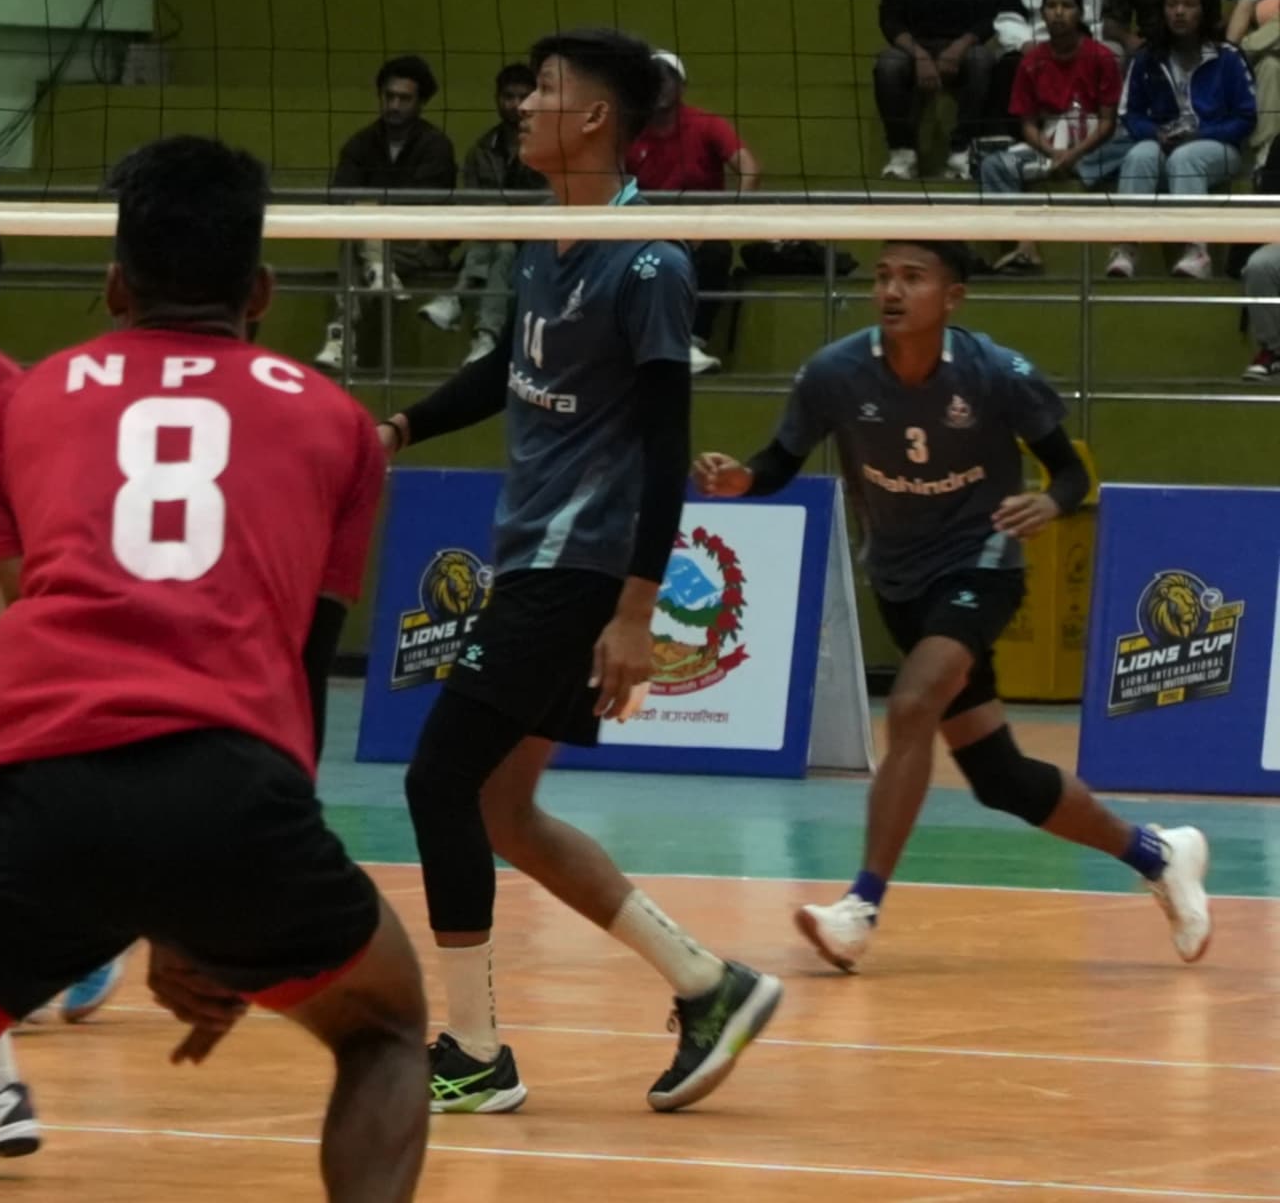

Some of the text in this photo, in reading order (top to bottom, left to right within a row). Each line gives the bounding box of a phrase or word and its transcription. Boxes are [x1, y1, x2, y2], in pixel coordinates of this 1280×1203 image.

[523, 310, 546, 369] 14
[905, 426, 929, 464] 3
[111, 395, 231, 582] 8
[400, 620, 458, 649] LIONS
[1116, 645, 1181, 675] LIONS
[1188, 632, 1233, 658] CUP
